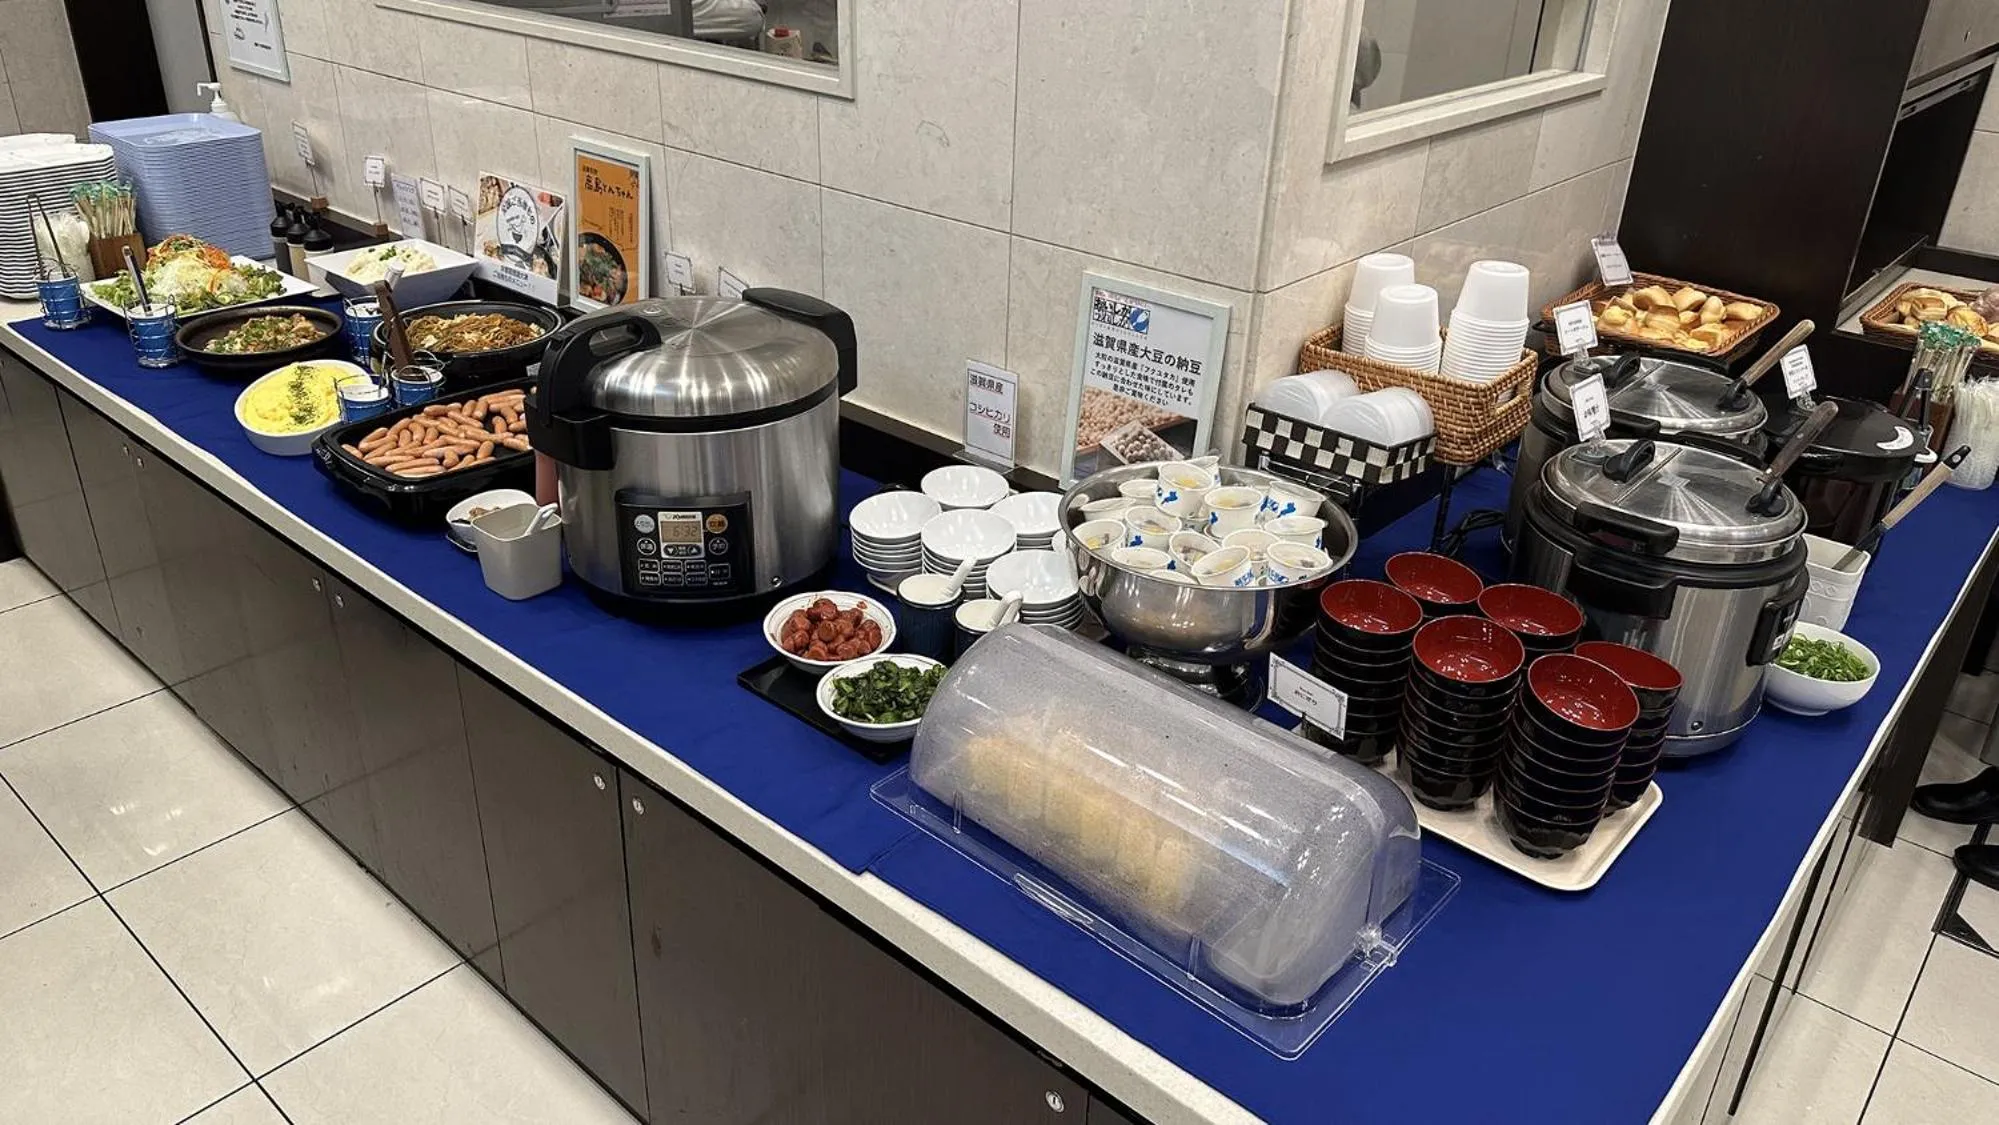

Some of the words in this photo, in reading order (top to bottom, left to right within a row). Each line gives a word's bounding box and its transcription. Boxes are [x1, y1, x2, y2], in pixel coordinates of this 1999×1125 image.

[1093, 332, 1202, 376] 滋賀県産大豆の納豆
[970, 374, 1003, 394] 滋賀県産
[970, 402, 1010, 424] コシヒカリ
[993, 423, 1011, 439] 使用
